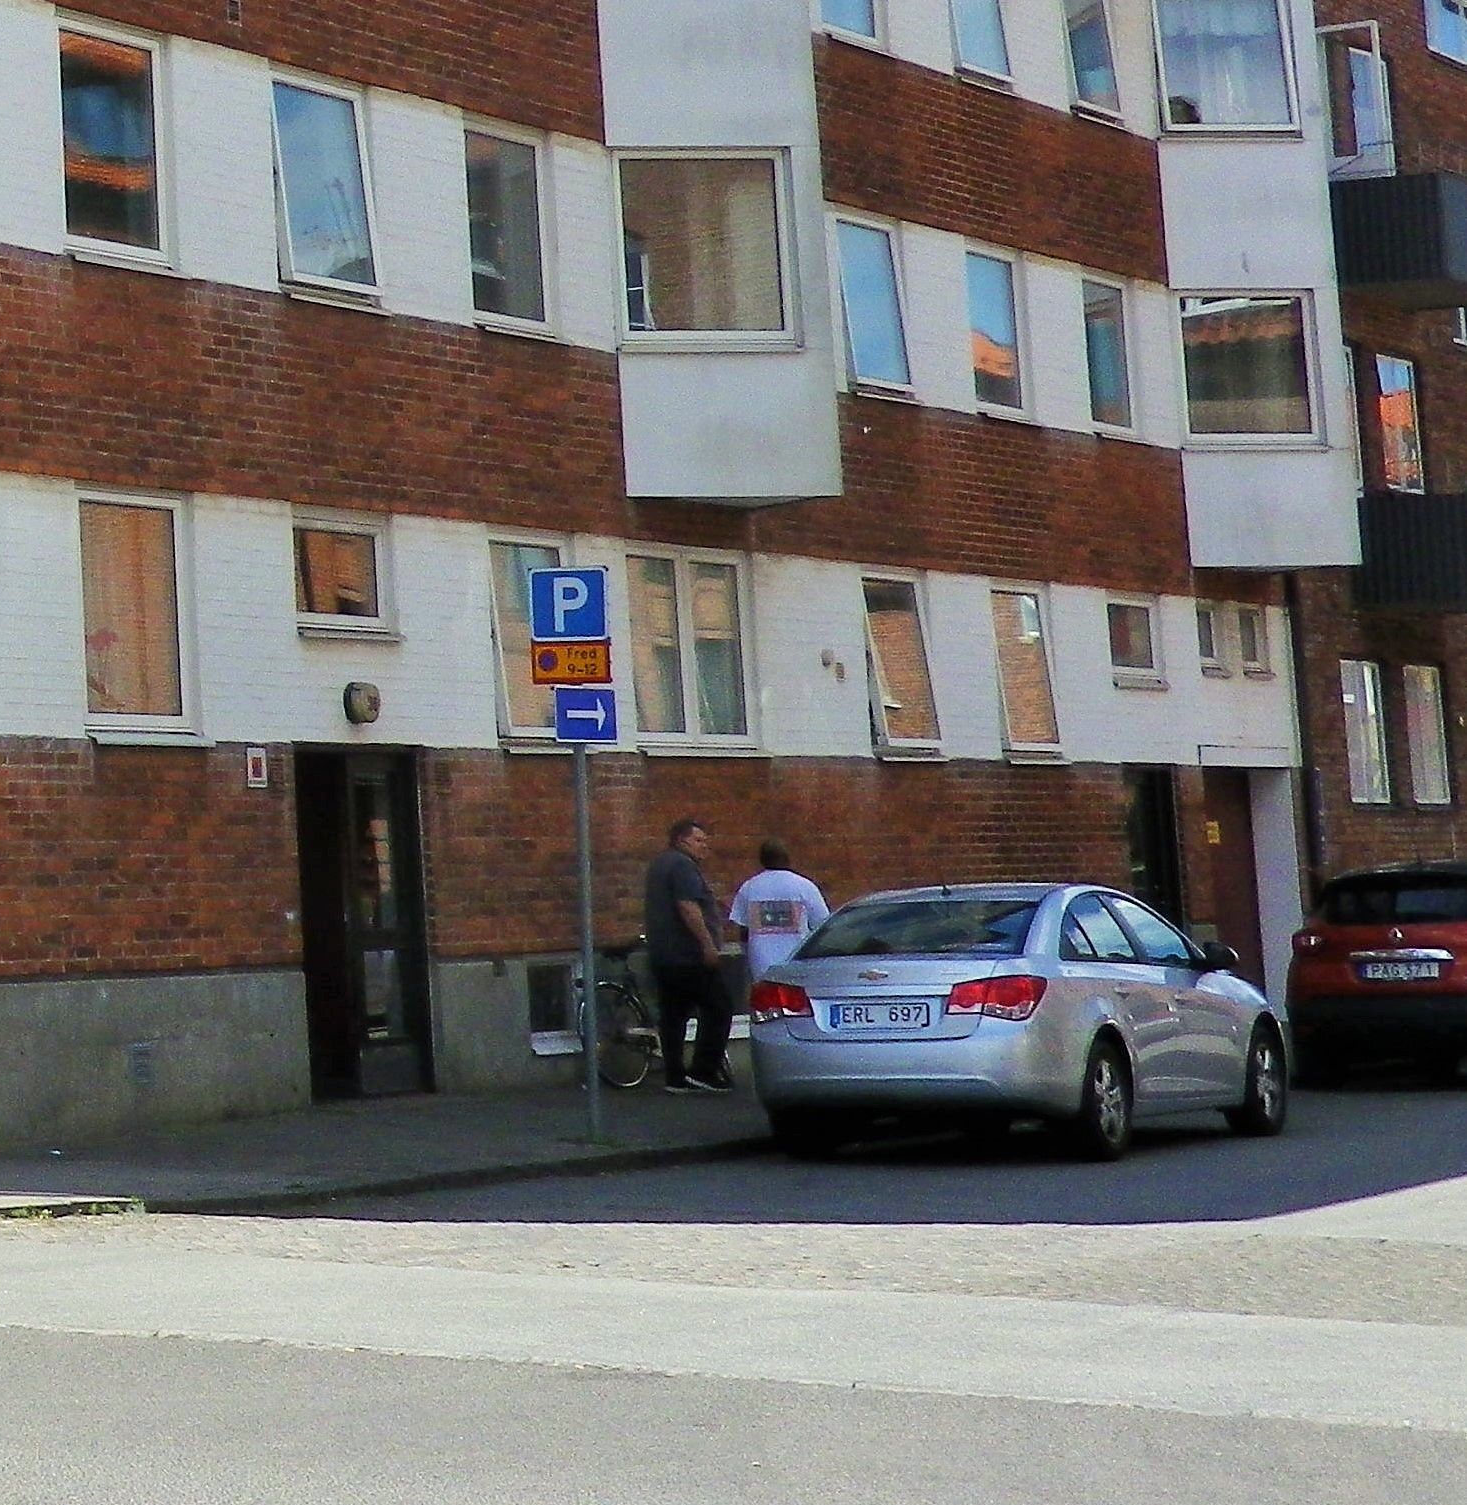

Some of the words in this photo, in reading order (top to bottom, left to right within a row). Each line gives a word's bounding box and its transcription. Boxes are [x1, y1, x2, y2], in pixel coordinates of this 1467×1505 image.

[553, 576, 588, 633] P
[842, 1006, 875, 1023] ERL
[889, 1006, 922, 1022] 697
